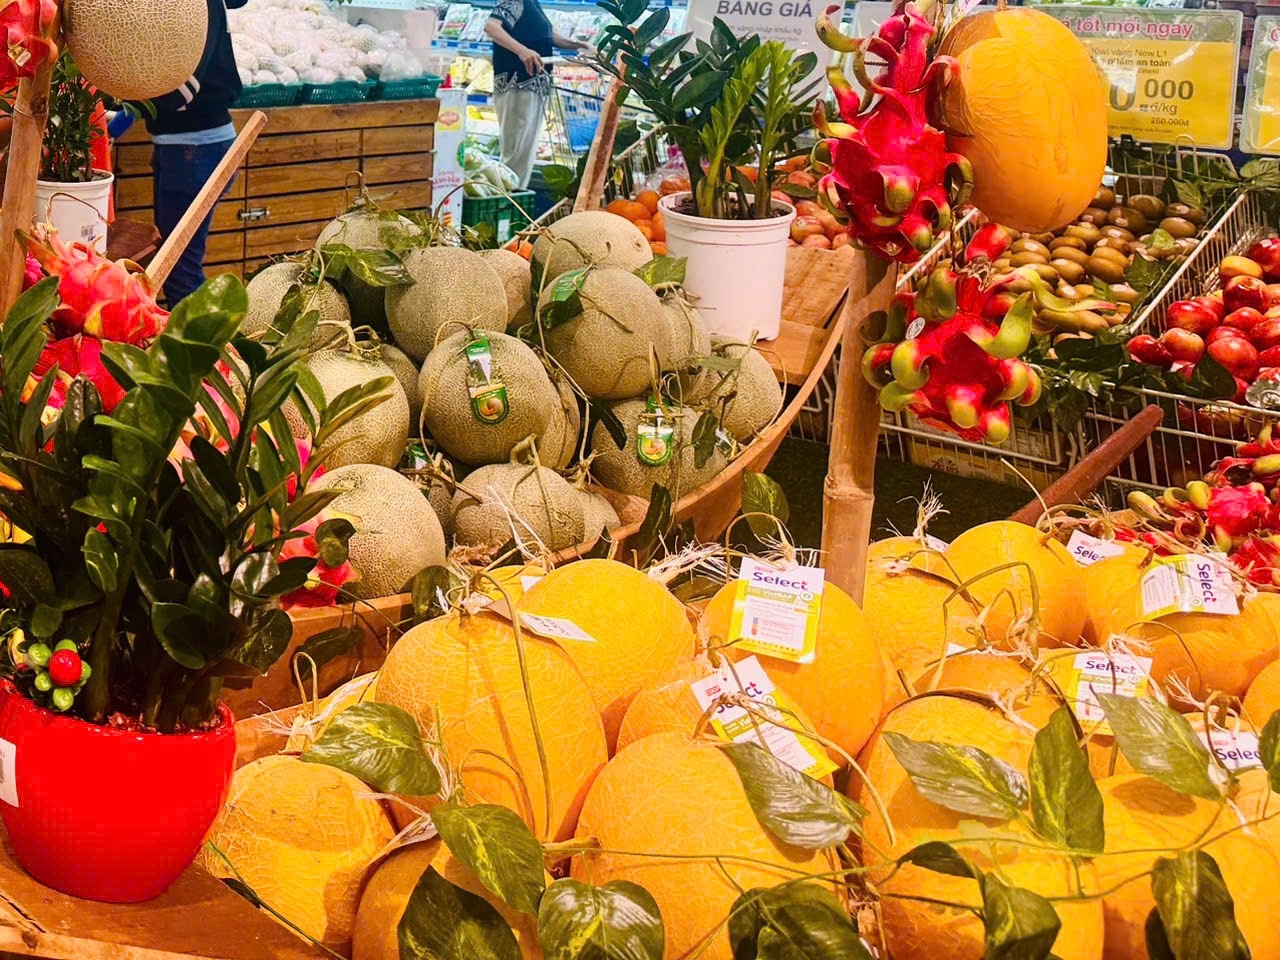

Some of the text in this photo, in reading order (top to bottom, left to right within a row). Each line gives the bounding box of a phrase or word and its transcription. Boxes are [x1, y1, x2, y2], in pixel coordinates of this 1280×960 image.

[779, 0, 813, 18] GIÁ
[1076, 17, 1101, 33] tốt
[1136, 59, 1148, 67] an
[1074, 545, 1106, 561] Sele
[752, 571, 808, 591] Select
[1197, 563, 1217, 602] Select
[1085, 660, 1137, 674] Select
[1215, 747, 1261, 761] Selec
